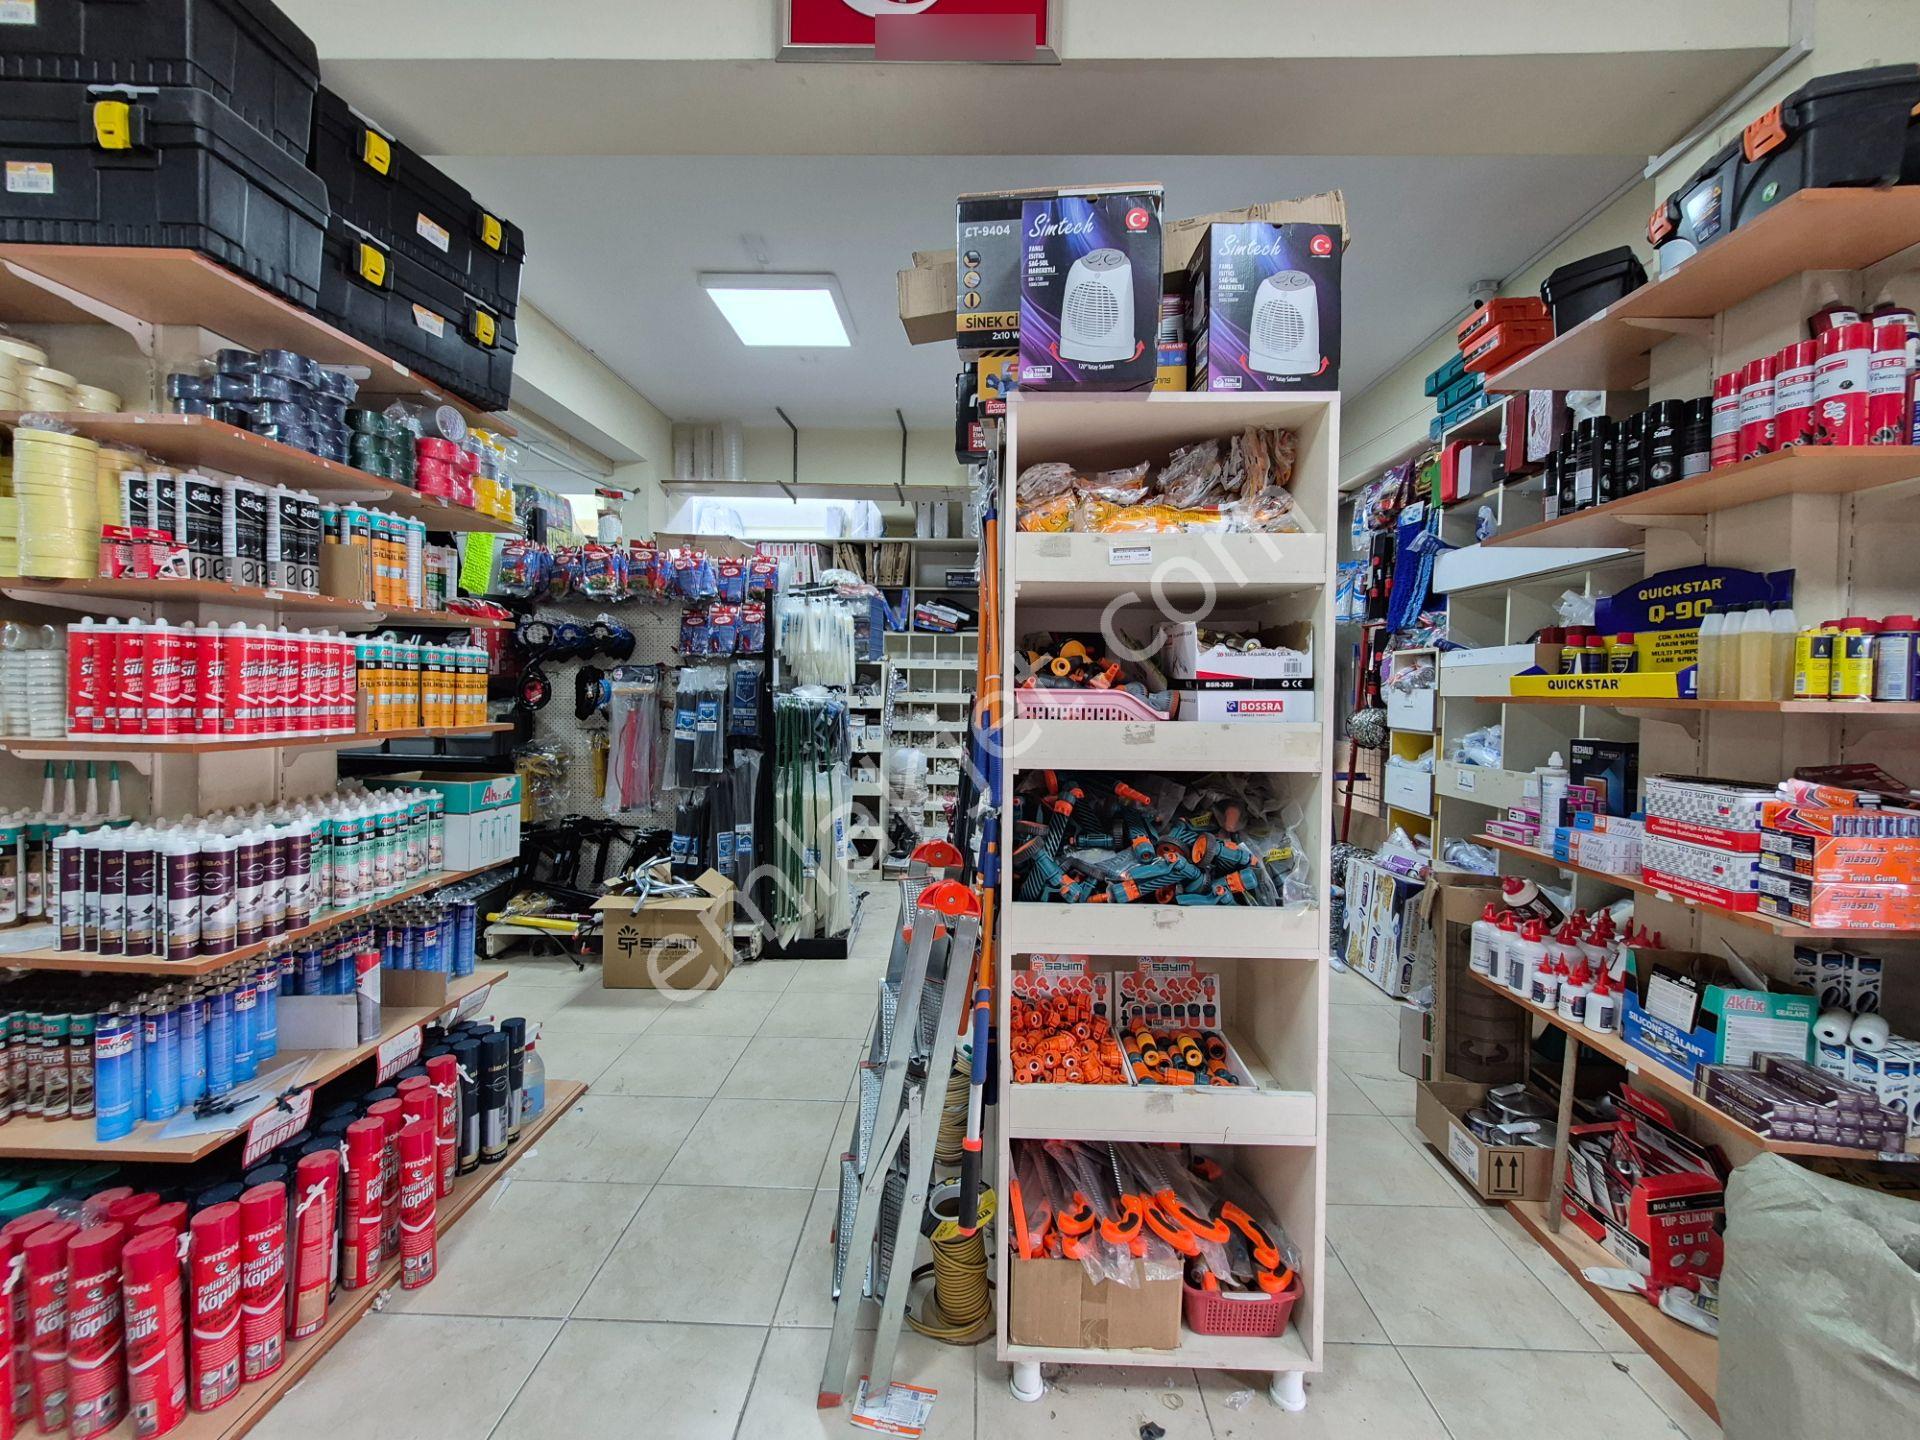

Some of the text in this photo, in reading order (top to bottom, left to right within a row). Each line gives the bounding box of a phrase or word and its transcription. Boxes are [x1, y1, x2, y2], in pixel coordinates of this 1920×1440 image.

[965, 225, 1010, 238] CT-9404
[1029, 212, 1095, 238] Simtech
[1219, 234, 1282, 256] Simtech
[966, 313, 1019, 329] SİNEK Cİ
[1638, 578, 1722, 600] QUICKSTAR
[1648, 599, 1713, 623] Q-90
[123, 664, 142, 676] Sili
[151, 664, 180, 677] Siliko
[1548, 679, 1620, 690] QUICKSTAR
[1241, 702, 1282, 711] BOSSRA
[1694, 792, 1715, 801] SUPER
[1717, 795, 1736, 803] GLUE
[1691, 848, 1711, 857] SUPER
[1714, 854, 1731, 862] GLUE
[1849, 874, 1898, 883] Twin Gum
[1846, 920, 1896, 929] Twin Gum
[257, 977, 277, 986] AYSON
[1725, 995, 1765, 1012] Akfix
[1628, 1010, 1705, 1058] SILICONE SEALANT
[405, 1155, 432, 1169] PITON
[401, 1181, 434, 1209] Köpük
[1653, 1201, 1687, 1211] BUL-MAX
[1660, 1211, 1714, 1228] TÜP SİLİKON
[247, 1224, 283, 1242] PITON
[203, 1241, 240, 1265] PITON
[39, 1267, 68, 1286] PITO
[75, 1266, 118, 1289] PITON
[244, 1251, 286, 1290] Köpük
[198, 1273, 242, 1315] Köpük
[35, 1311, 67, 1337] Köp
[127, 1317, 159, 1343] pük
